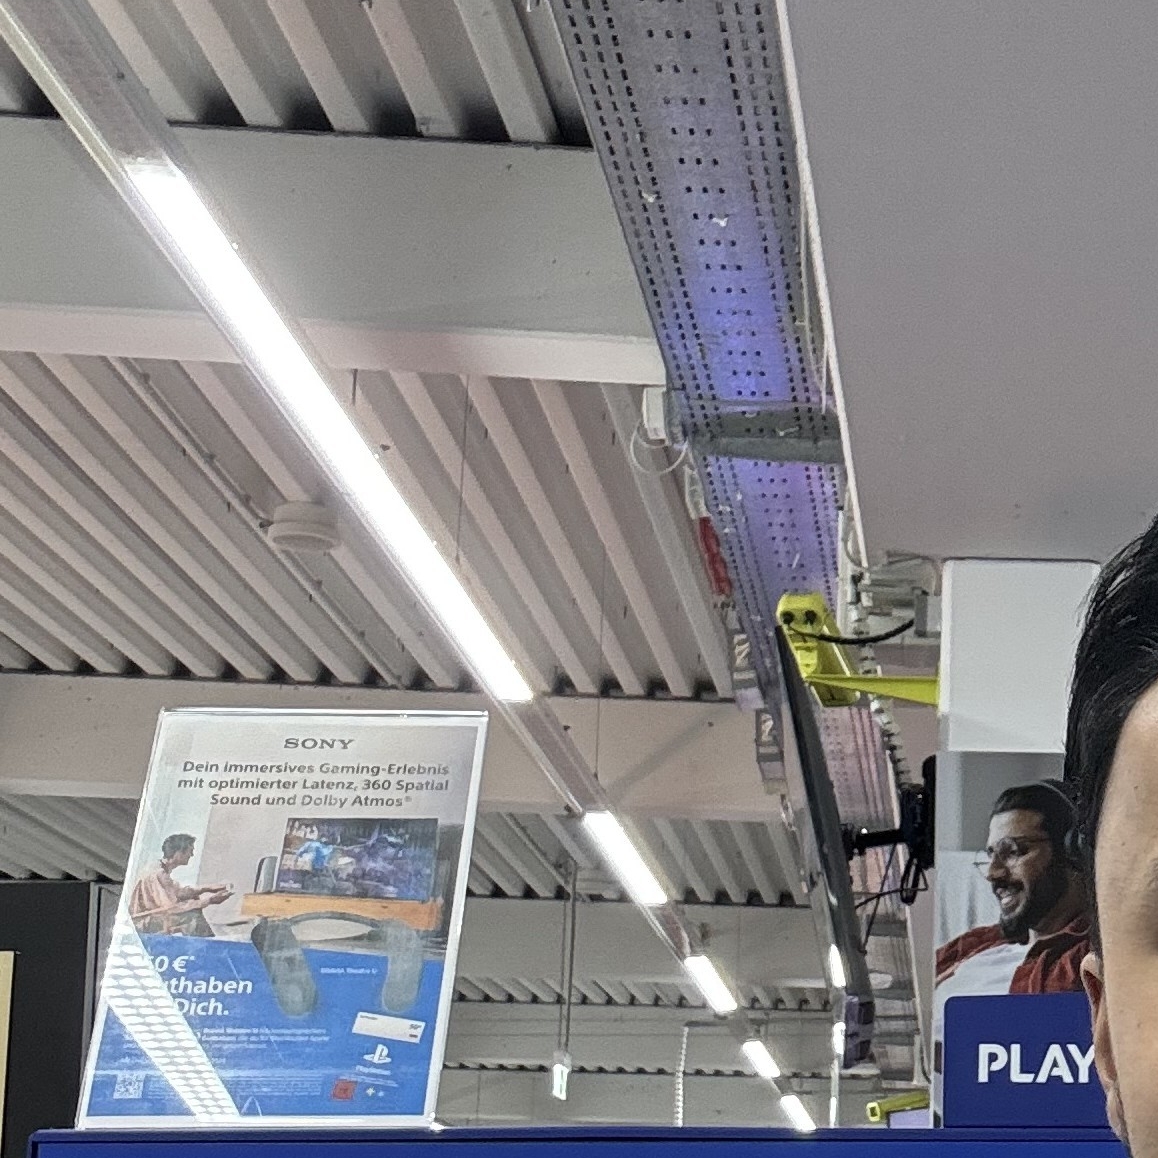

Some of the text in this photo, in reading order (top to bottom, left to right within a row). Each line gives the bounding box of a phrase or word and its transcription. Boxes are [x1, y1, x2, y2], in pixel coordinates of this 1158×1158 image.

[284, 738, 355, 749] SONY
[183, 761, 449, 777] Dein immersives Gaming-Erlebnis
[178, 778, 449, 793] mit optimierter Latenz, 360 Spatial
[210, 794, 261, 806] Sound
[265, 794, 297, 806] und
[301, 794, 348, 808] Dolby
[165, 976, 253, 995] thaben
[977, 1043, 1095, 1083] PLAY
